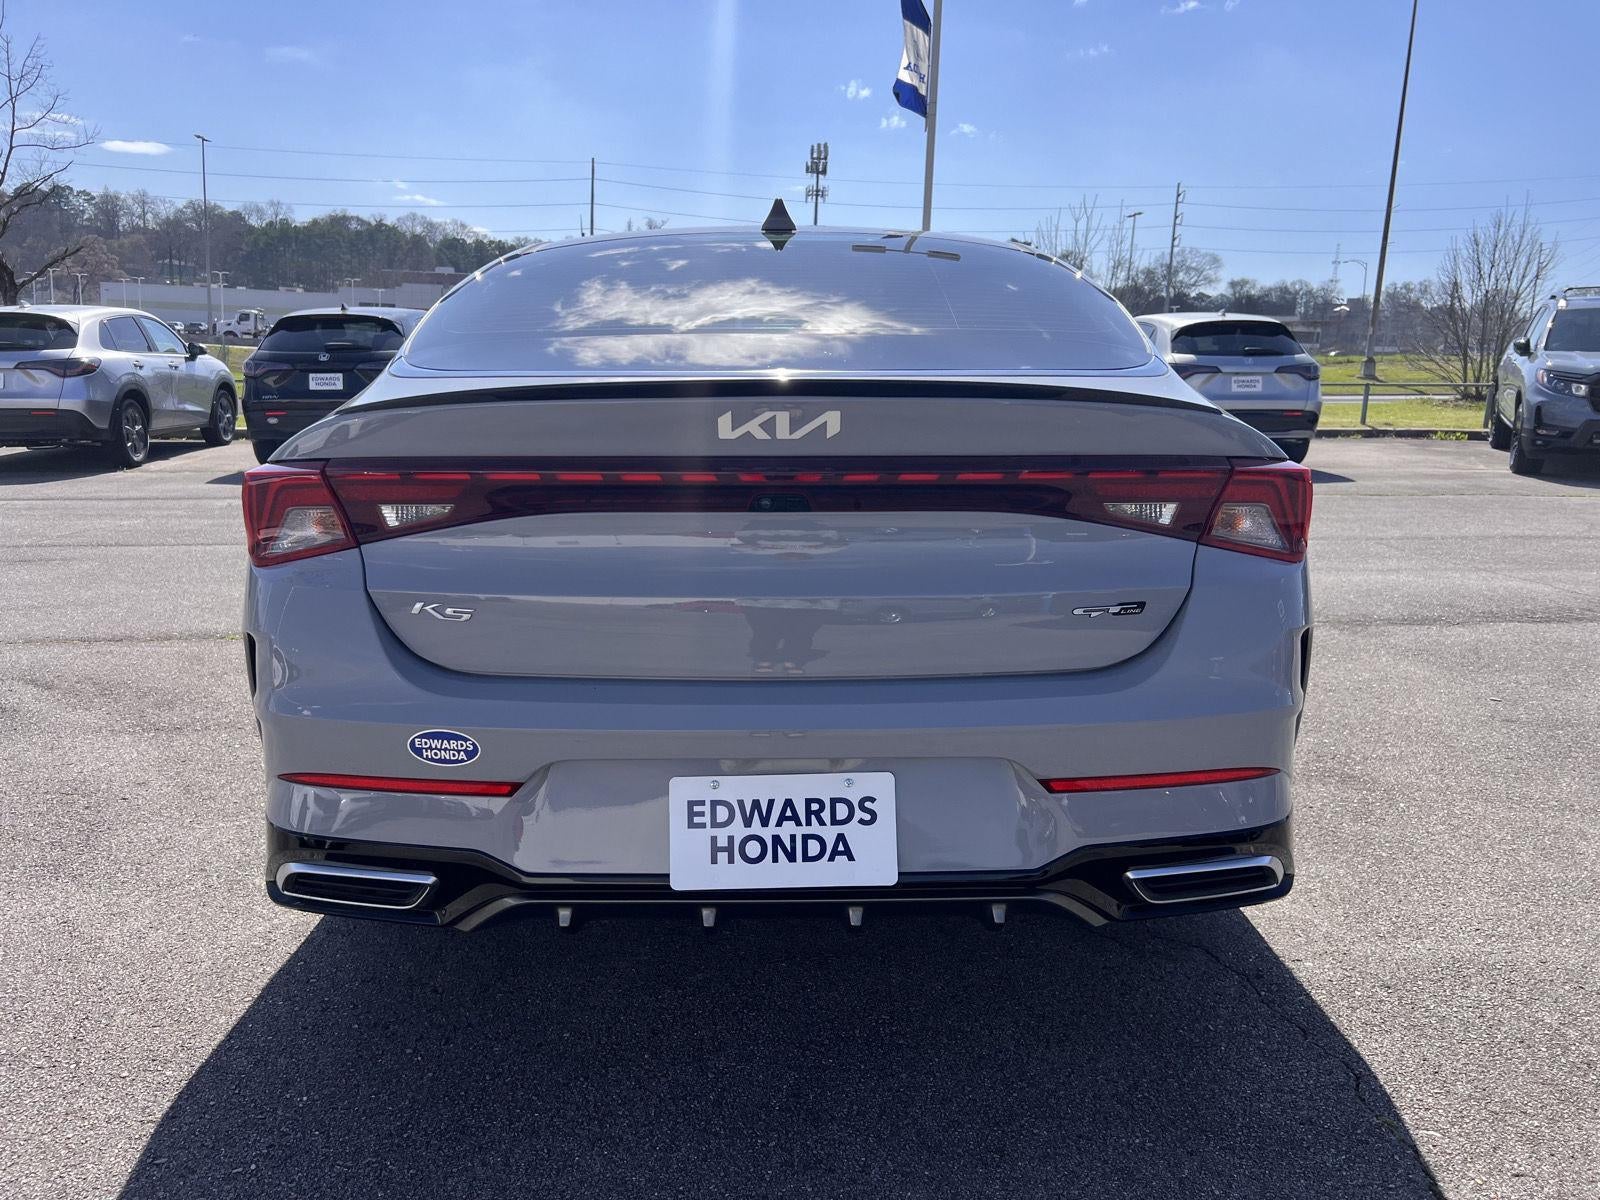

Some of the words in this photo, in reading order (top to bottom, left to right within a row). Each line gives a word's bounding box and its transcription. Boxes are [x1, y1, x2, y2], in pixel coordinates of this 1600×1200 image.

[717, 410, 841, 440] KIA
[411, 602, 475, 621] K5
[414, 738, 474, 751] EDWARDS
[422, 749, 468, 761] HONDA
[686, 795, 878, 829] EDWARDS
[710, 833, 856, 865] HONDA
